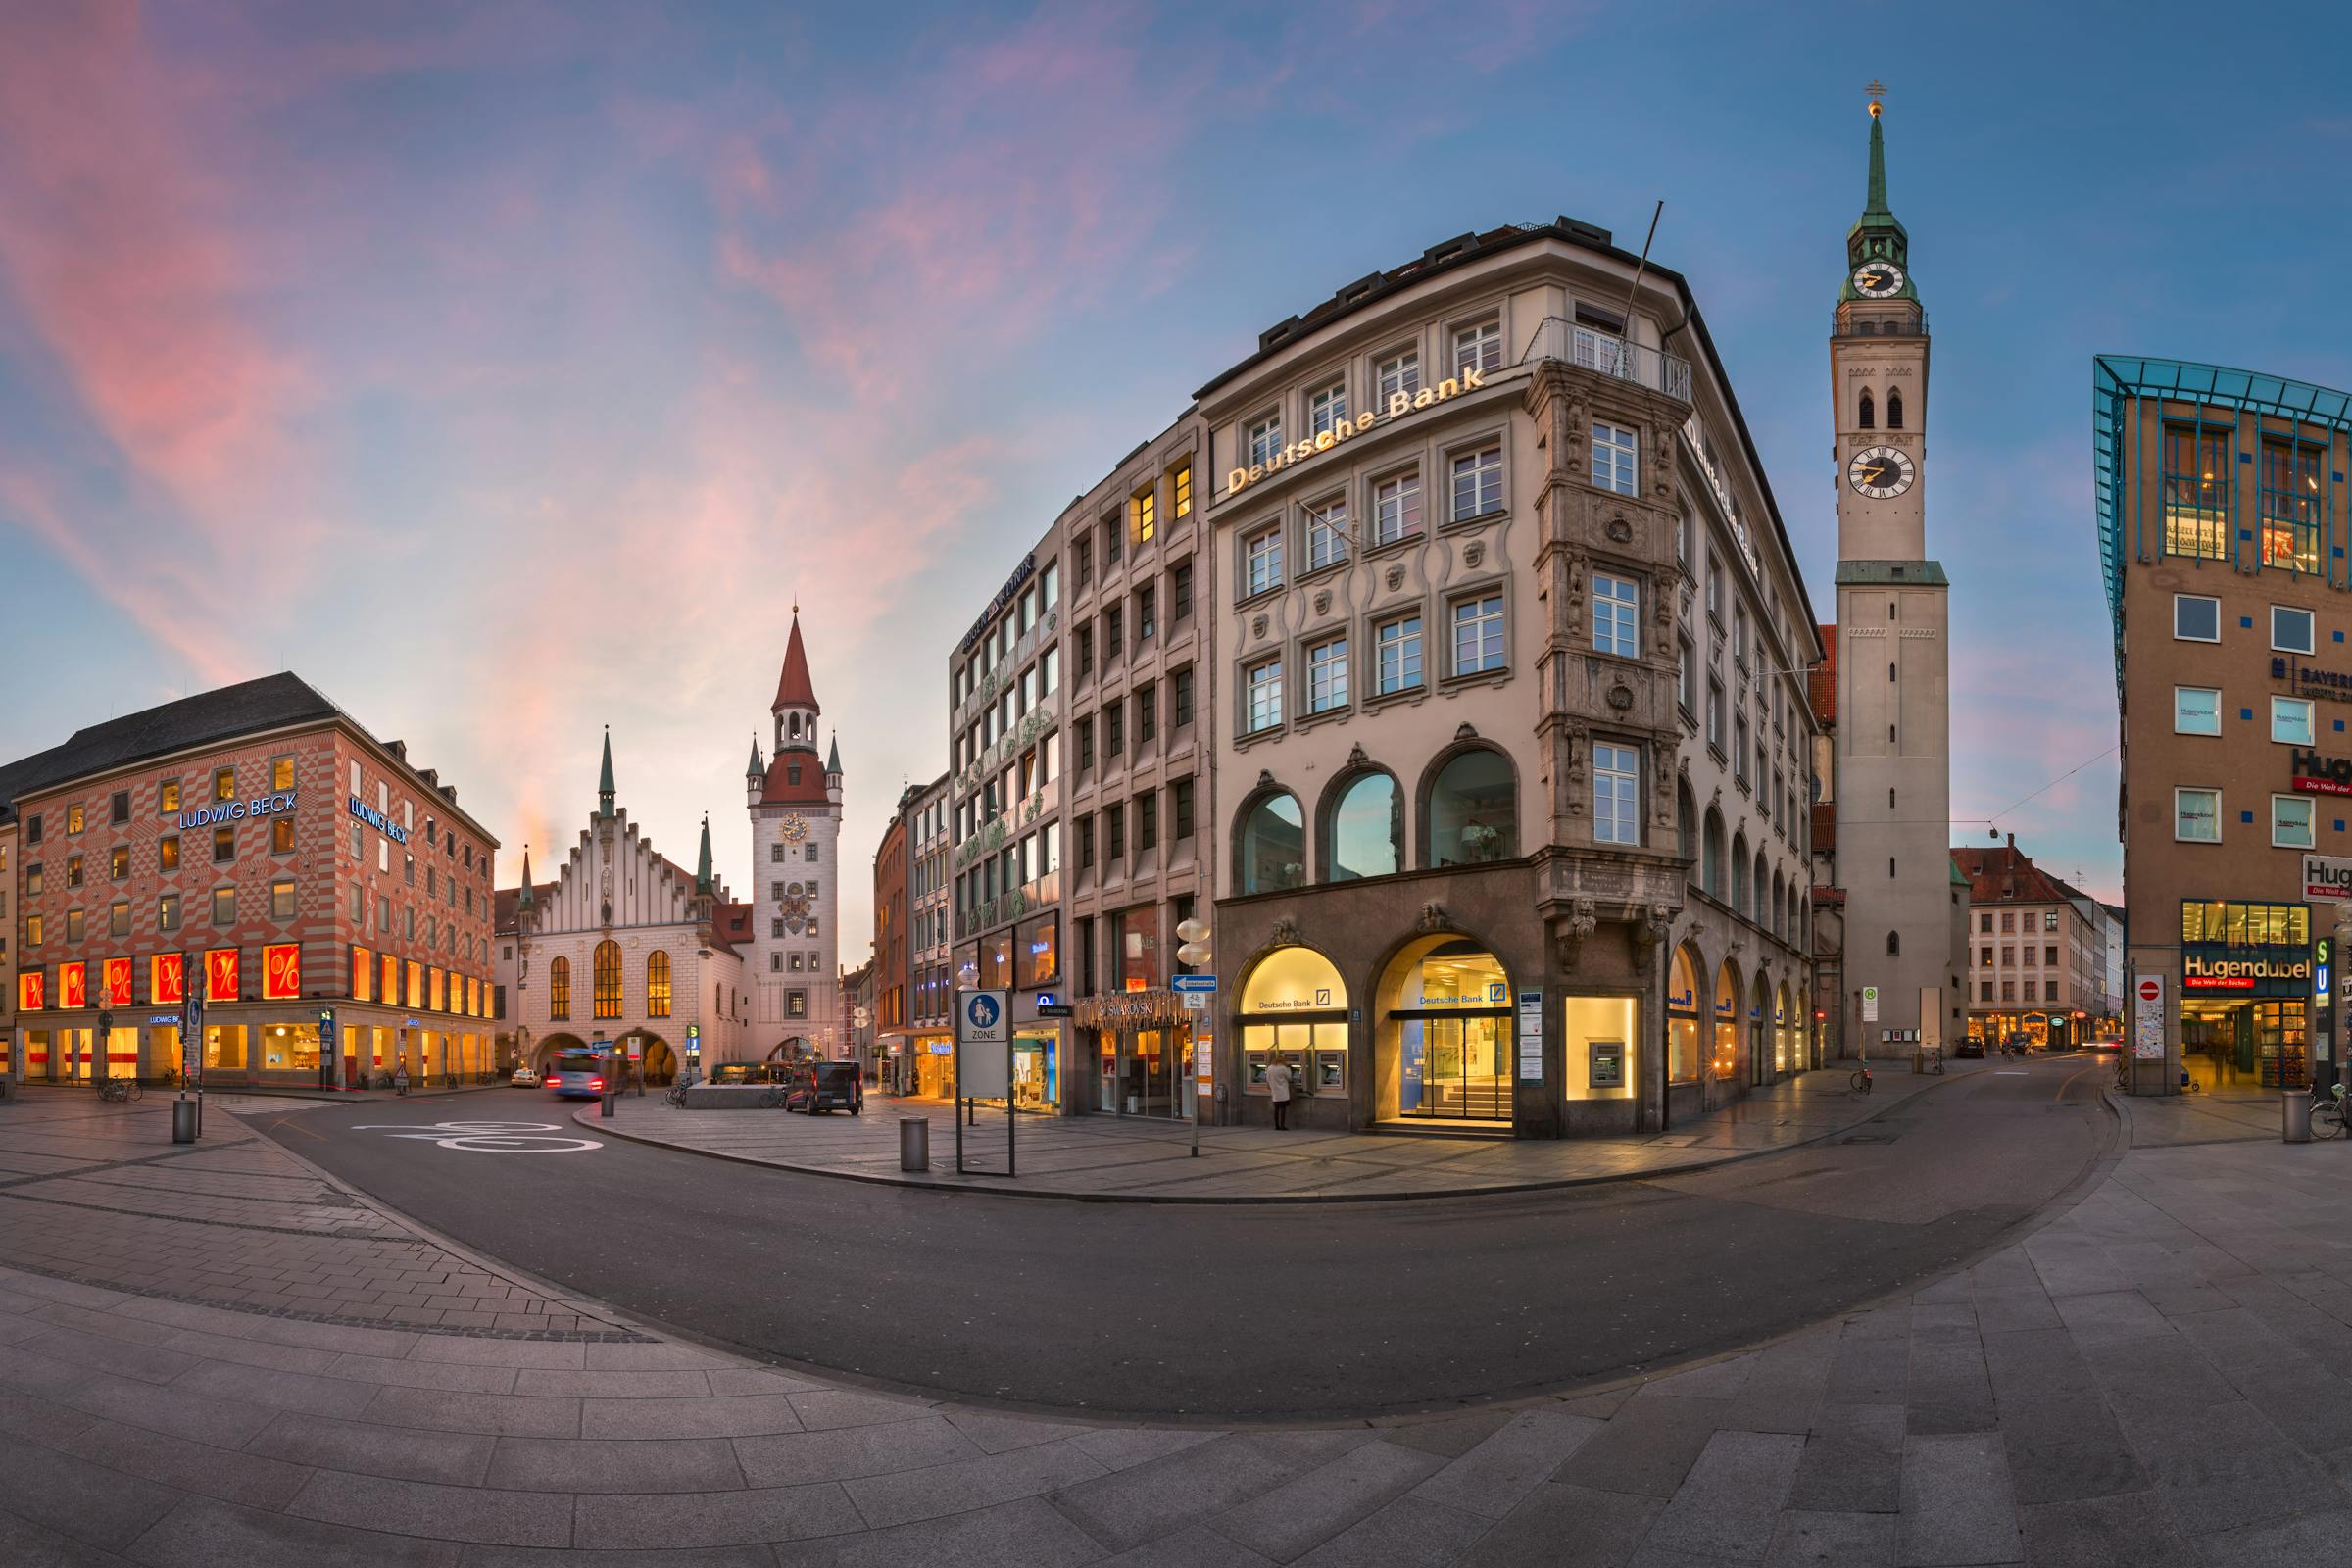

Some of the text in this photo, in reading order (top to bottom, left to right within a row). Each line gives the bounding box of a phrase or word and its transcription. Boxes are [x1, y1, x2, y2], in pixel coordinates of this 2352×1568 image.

[1227, 366, 1486, 496] Deutsche Bank
[1687, 417, 1758, 581] Deutsche Bank
[2292, 748, 2352, 785] Hug
[179, 792, 298, 830] LUDWIG BECK
[350, 797, 409, 846] LUDWIG BECK
[2318, 941, 2328, 963] S
[2184, 956, 2311, 979] Hugendubel
[2318, 969, 2327, 991] U
[1108, 1002, 1153, 1016] SWAROVSKI
[1259, 999, 1311, 1009] Deutsche Bank
[1419, 994, 1483, 1004] Deutsche Bank
[150, 1015, 172, 1024] LUDWIG
[972, 1030, 997, 1039] ZONE
